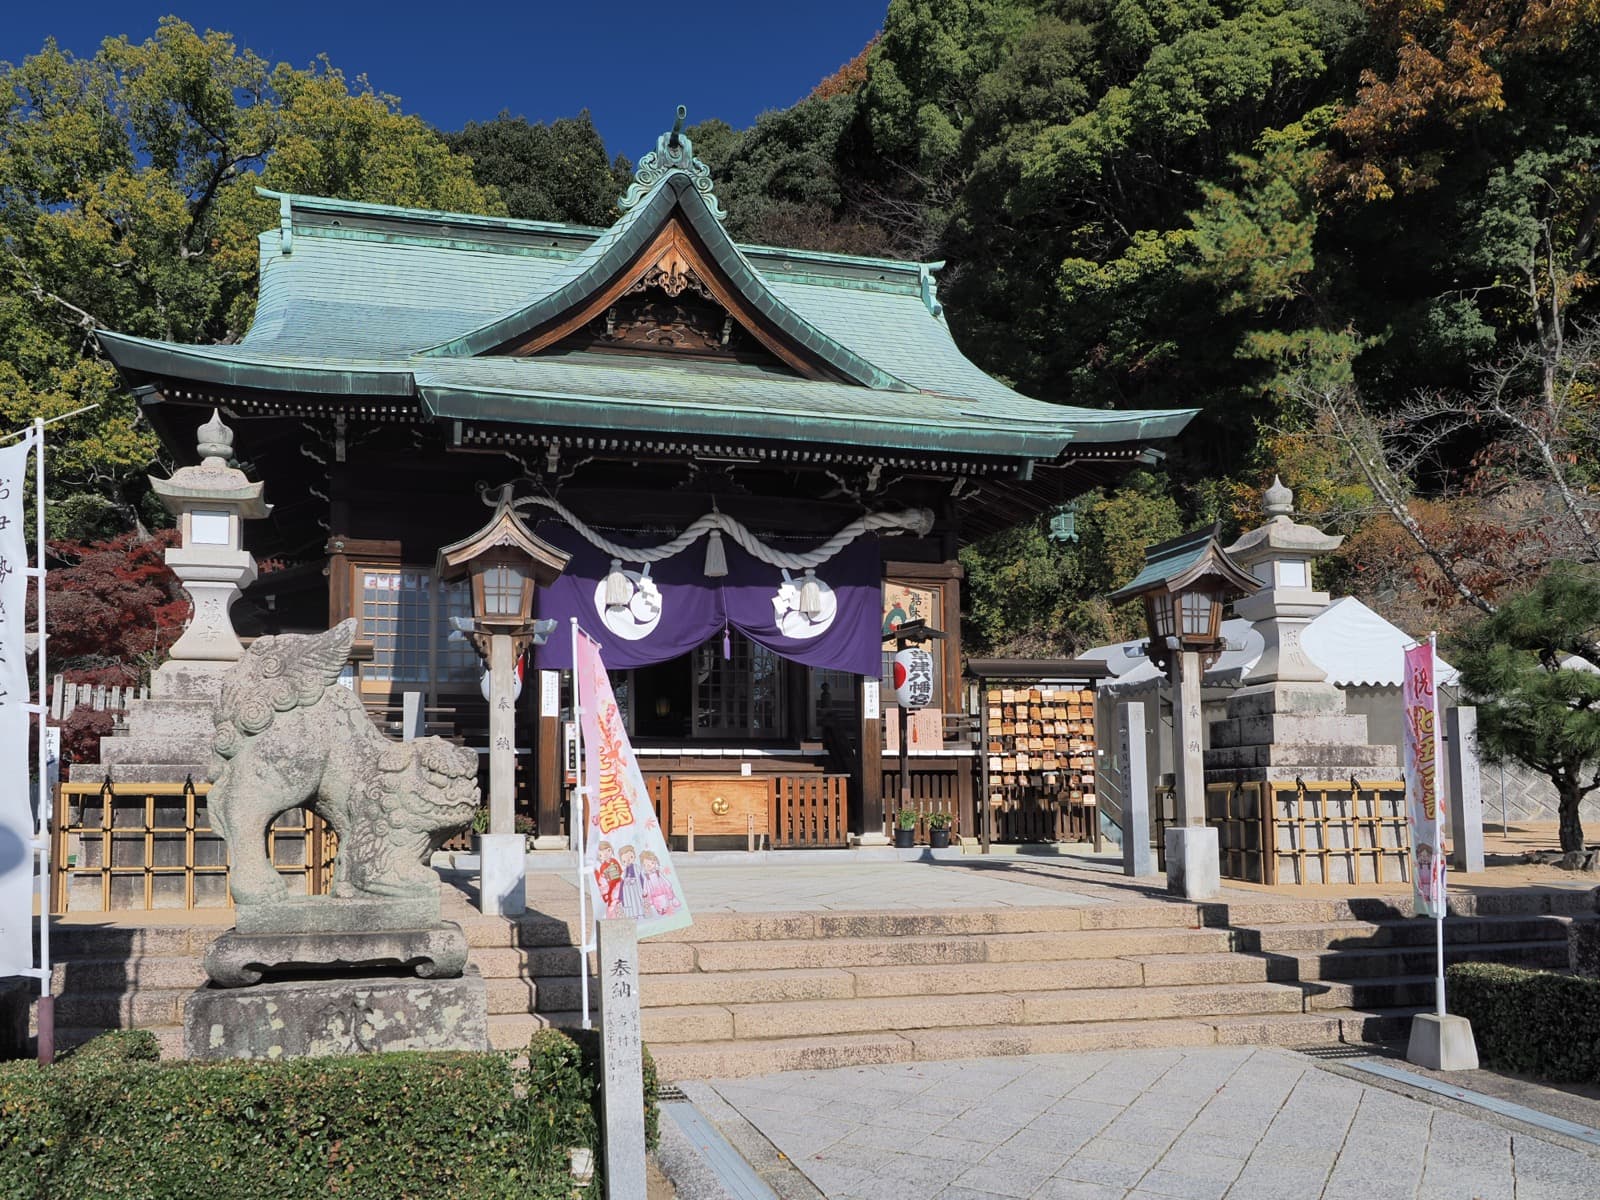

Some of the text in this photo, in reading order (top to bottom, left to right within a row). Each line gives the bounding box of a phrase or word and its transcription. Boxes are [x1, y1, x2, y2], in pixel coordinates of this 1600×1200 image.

[909, 650, 930, 705] 草津八幡宮
[1414, 667, 1433, 700] 祝
[610, 958, 632, 999] 奉納
